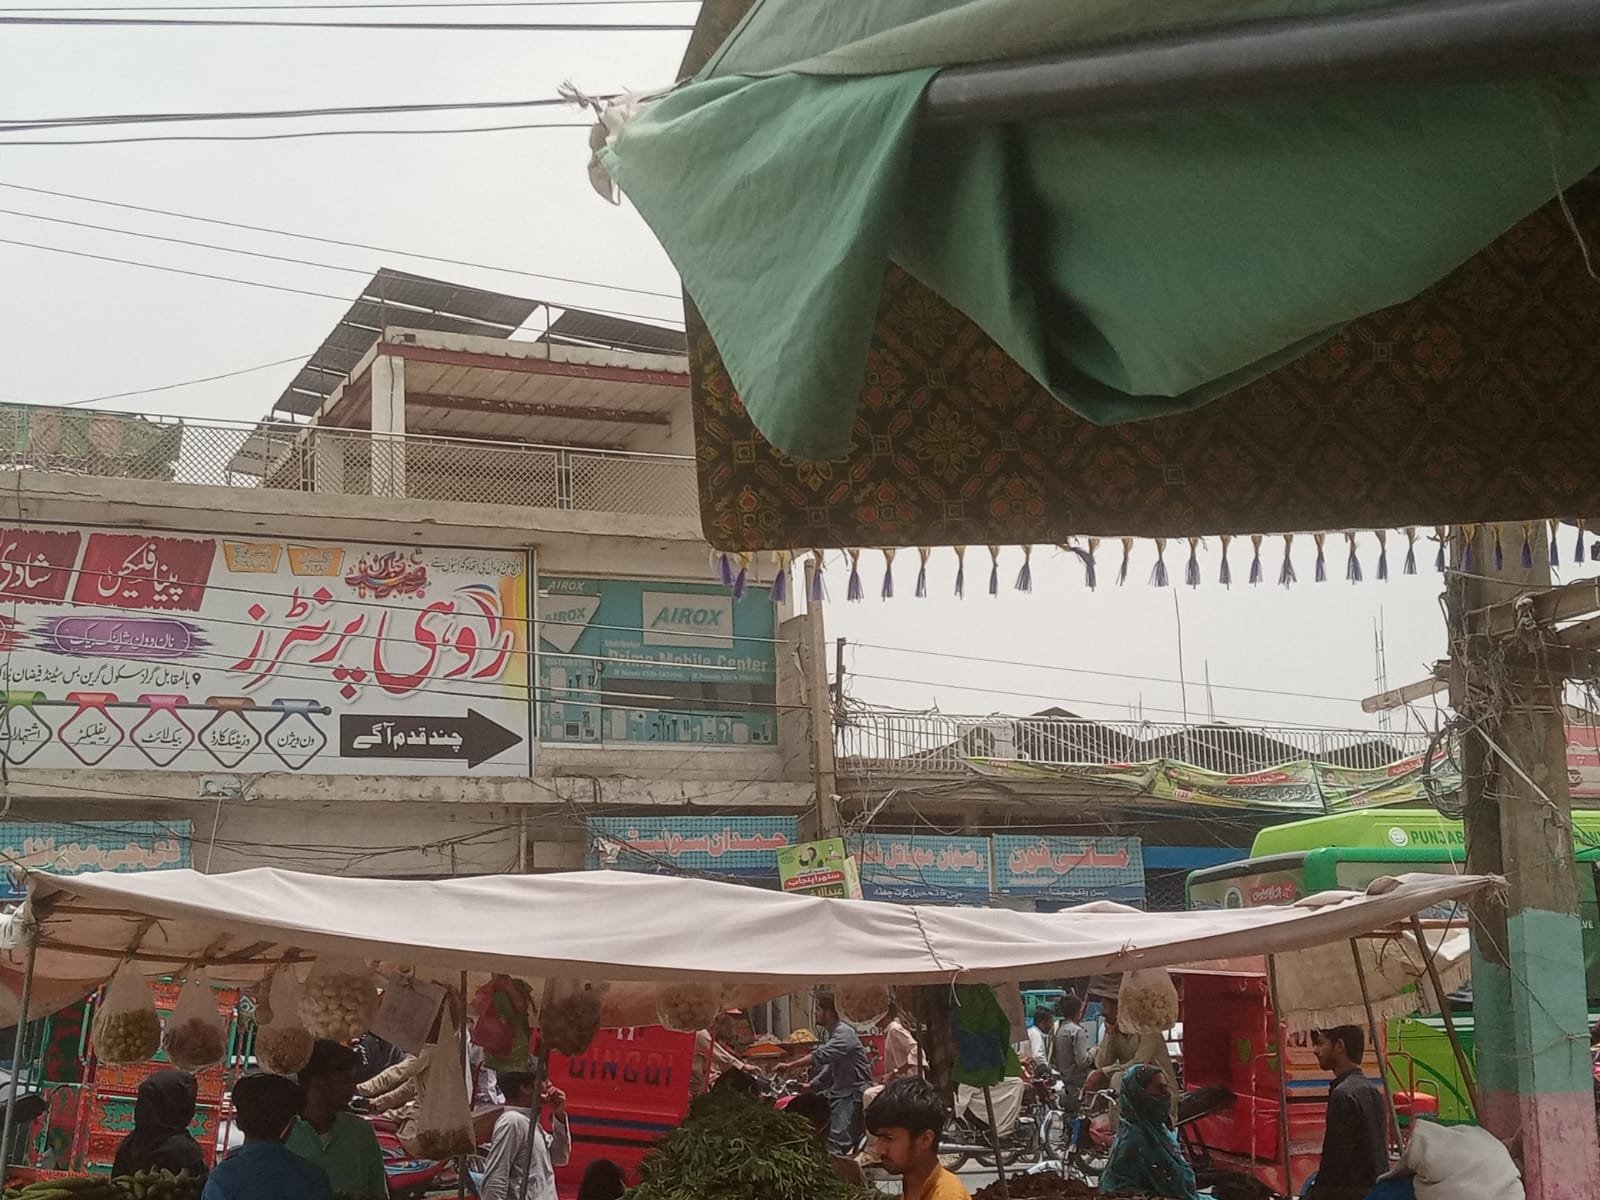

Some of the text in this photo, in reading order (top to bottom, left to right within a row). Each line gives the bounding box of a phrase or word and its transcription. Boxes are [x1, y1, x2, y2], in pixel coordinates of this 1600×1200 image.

[547, 580, 585, 593] AIROX
[542, 607, 587, 629] AIROX
[651, 606, 723, 627] AIROX
[229, 586, 368, 699] پرنٹرز
[607, 648, 654, 668] Prime
[659, 651, 712, 669] Mobile
[717, 654, 768, 672] Center
[101, 664, 145, 686] سکول
[155, 668, 190, 689] بالمقابل
[277, 731, 300, 749] ویژن
[353, 722, 464, 752] چند قدم آگے
[1411, 830, 1465, 845] PUNJAB
[1008, 838, 1051, 875] فون
